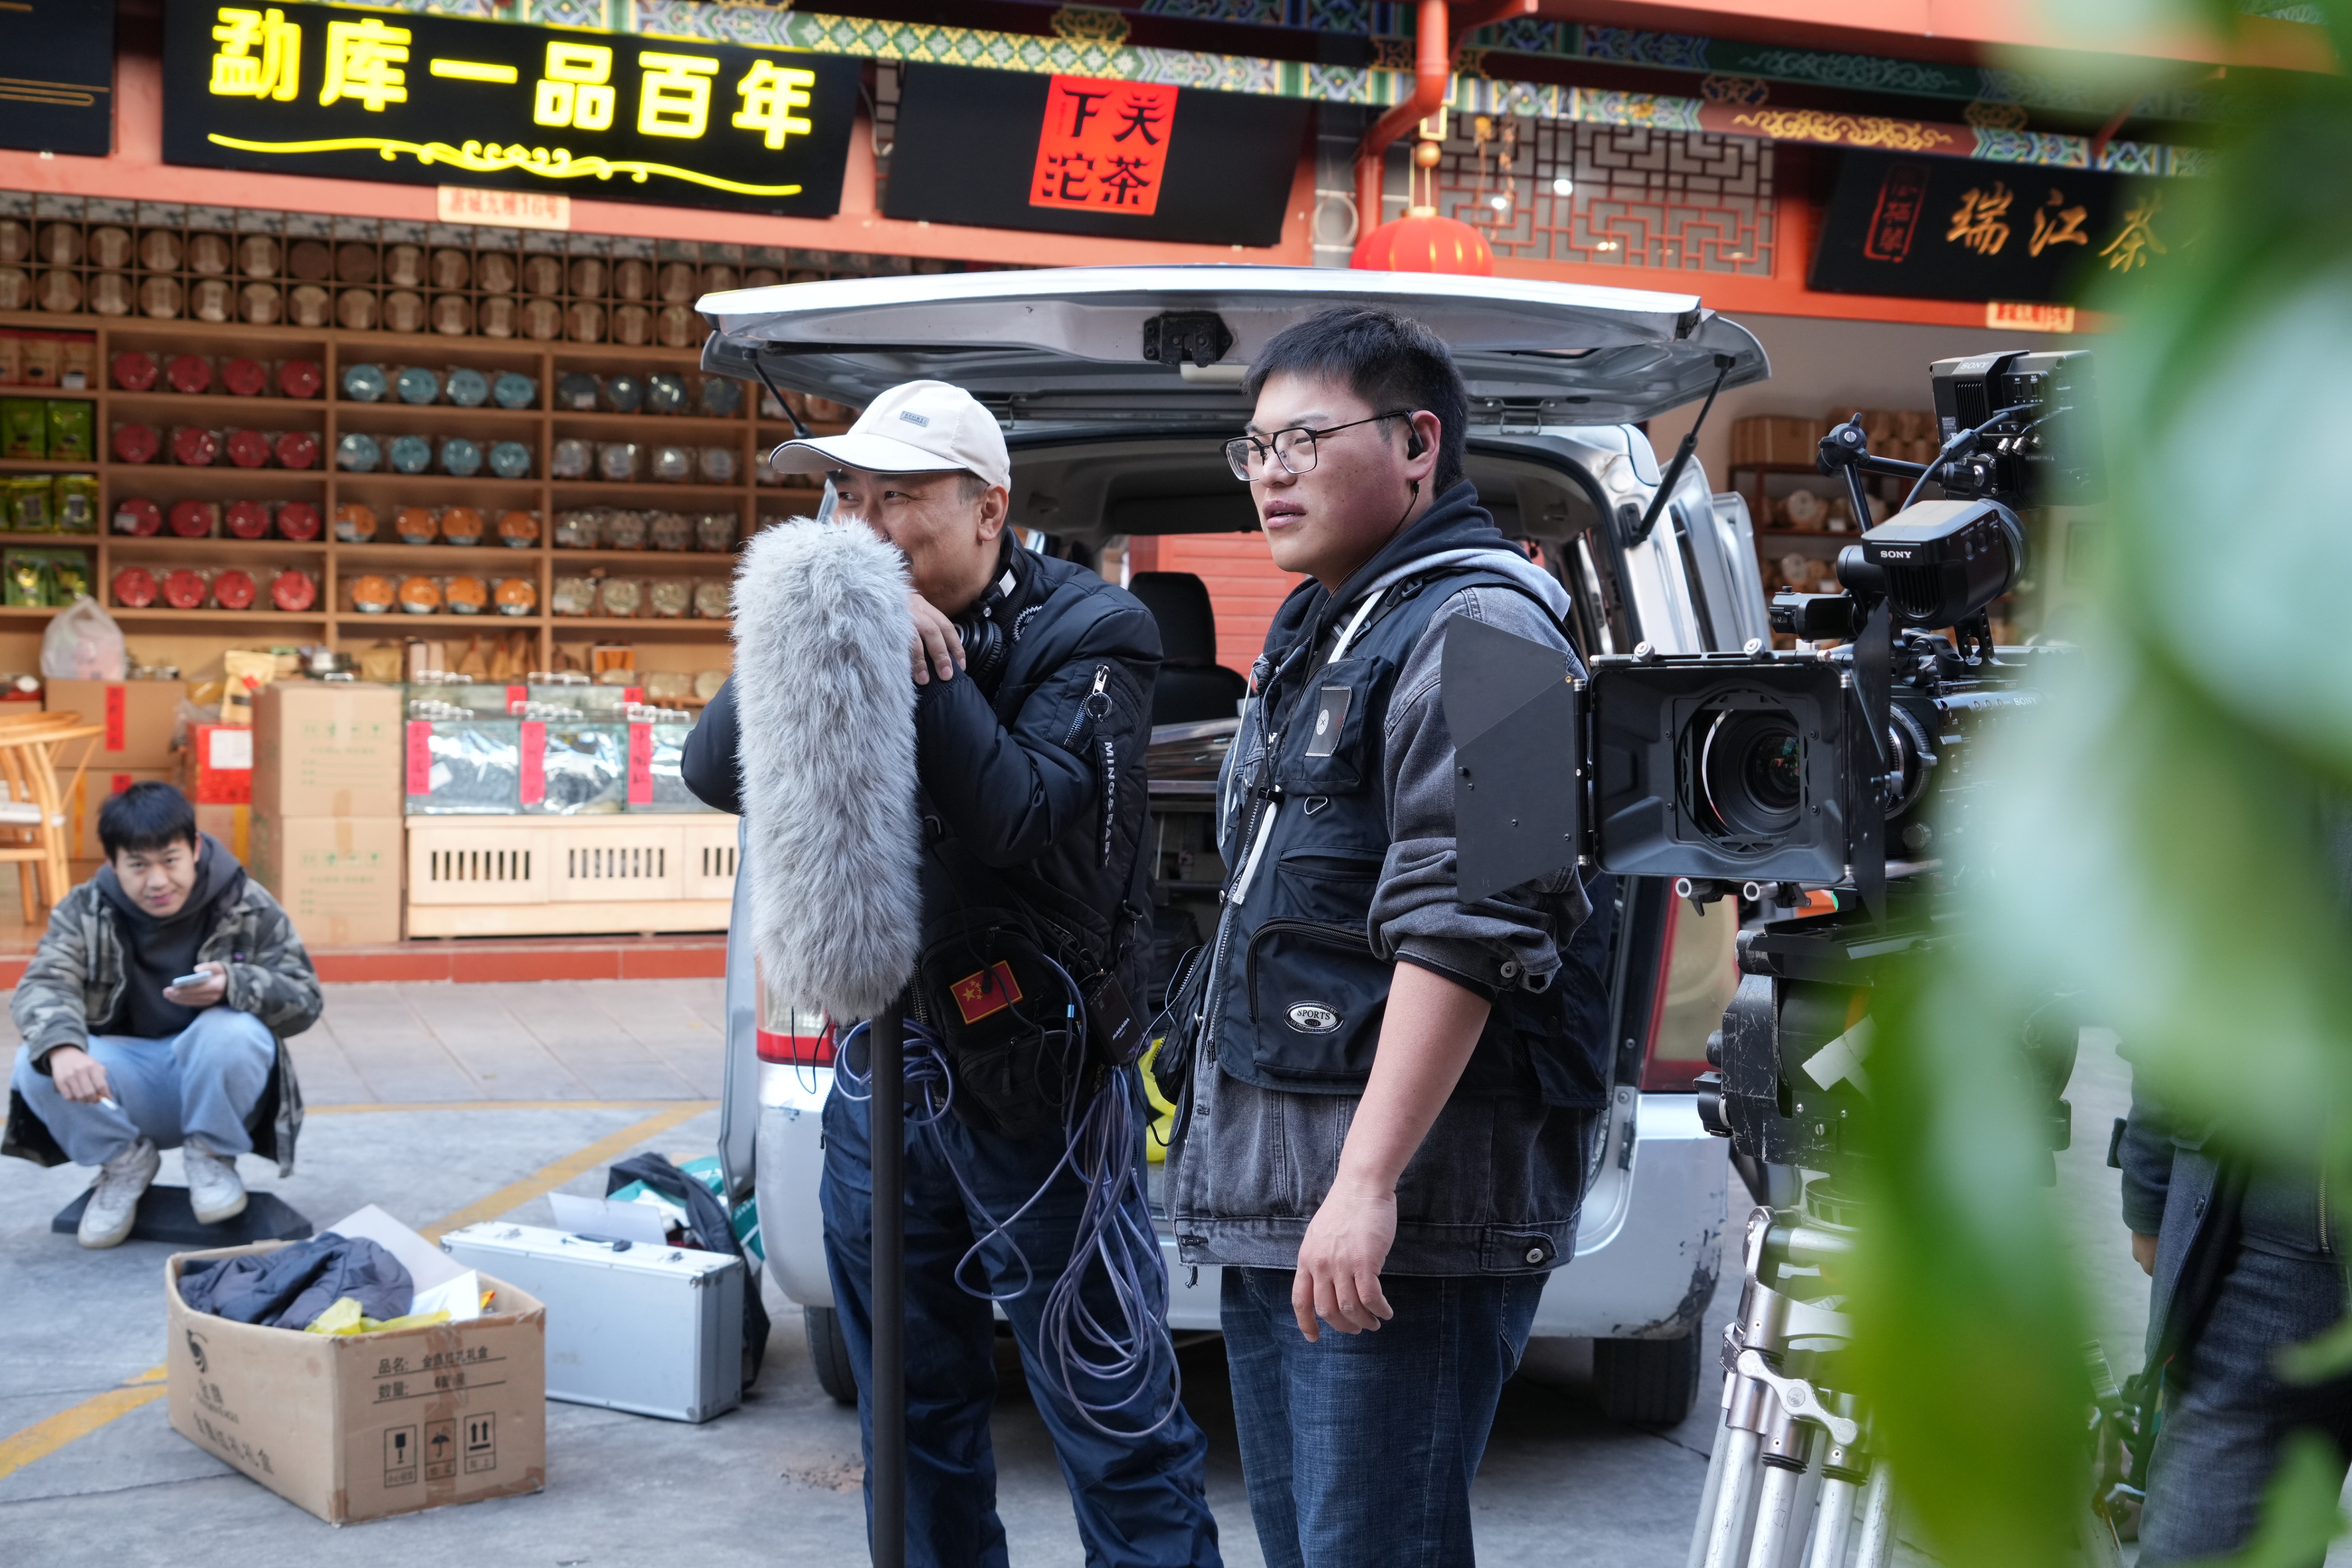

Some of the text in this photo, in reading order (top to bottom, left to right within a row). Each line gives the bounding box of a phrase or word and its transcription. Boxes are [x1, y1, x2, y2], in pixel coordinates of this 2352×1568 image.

[209, 7, 815, 150] 勐库一品百年
[1880, 550, 1912, 559] SONY
[2013, 697, 2037, 706] SONY
[1297, 1009, 1330, 1020] SPORTS
